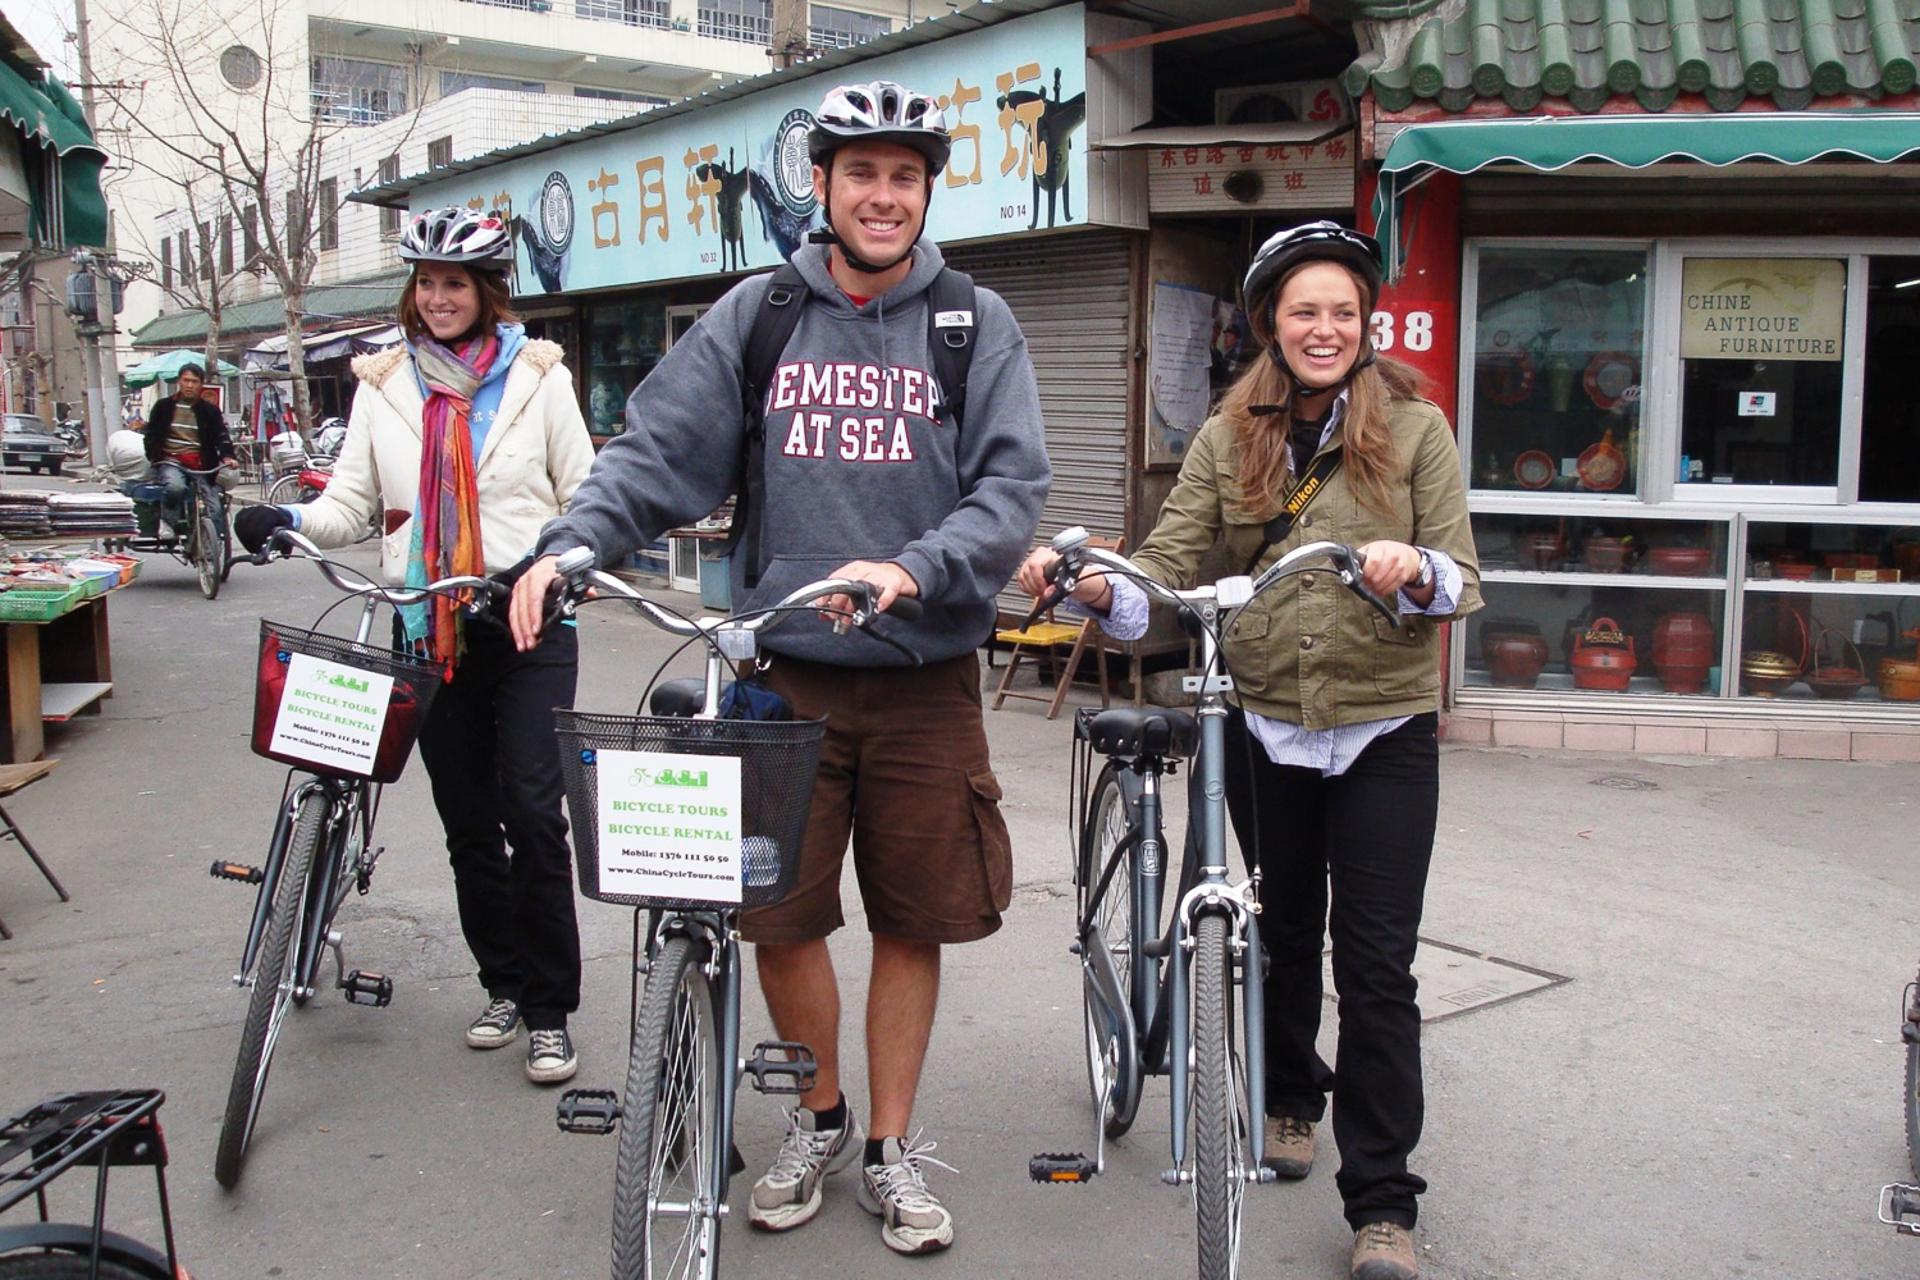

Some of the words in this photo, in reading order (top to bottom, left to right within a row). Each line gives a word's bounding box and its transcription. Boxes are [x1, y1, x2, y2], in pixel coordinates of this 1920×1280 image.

[938, 62, 1047, 188] 古玩
[588, 143, 721, 249] 古月轩
[1000, 205, 1014, 219] NO
[1017, 204, 1026, 216] 14
[1687, 295, 1751, 310] CHINE
[1369, 311, 1433, 352] 38
[1704, 317, 1800, 332] ANTIQUE
[1720, 338, 1836, 354] FURNITURE
[763, 361, 943, 424] EMESTER
[783, 411, 832, 458] AT
[839, 416, 913, 462] SEA
[1287, 477, 1319, 514] Nikon
[294, 688, 340, 706] BICYCLE
[342, 700, 377, 715] TOURS
[287, 704, 333, 721] BICYCLE
[335, 716, 377, 732] RENTAL
[612, 800, 674, 814] BICYCLE
[678, 804, 728, 818] TOURS
[608, 823, 670, 837] BICYCLE
[674, 827, 733, 841] RENTAL
[621, 848, 657, 858] Mobile:
[659, 851, 682, 861] 1376
[685, 853, 700, 861] 111
[703, 854, 715, 862] 50
[717, 854, 729, 863] 50
[608, 866, 735, 881] www.ChinaCycleTours.com
